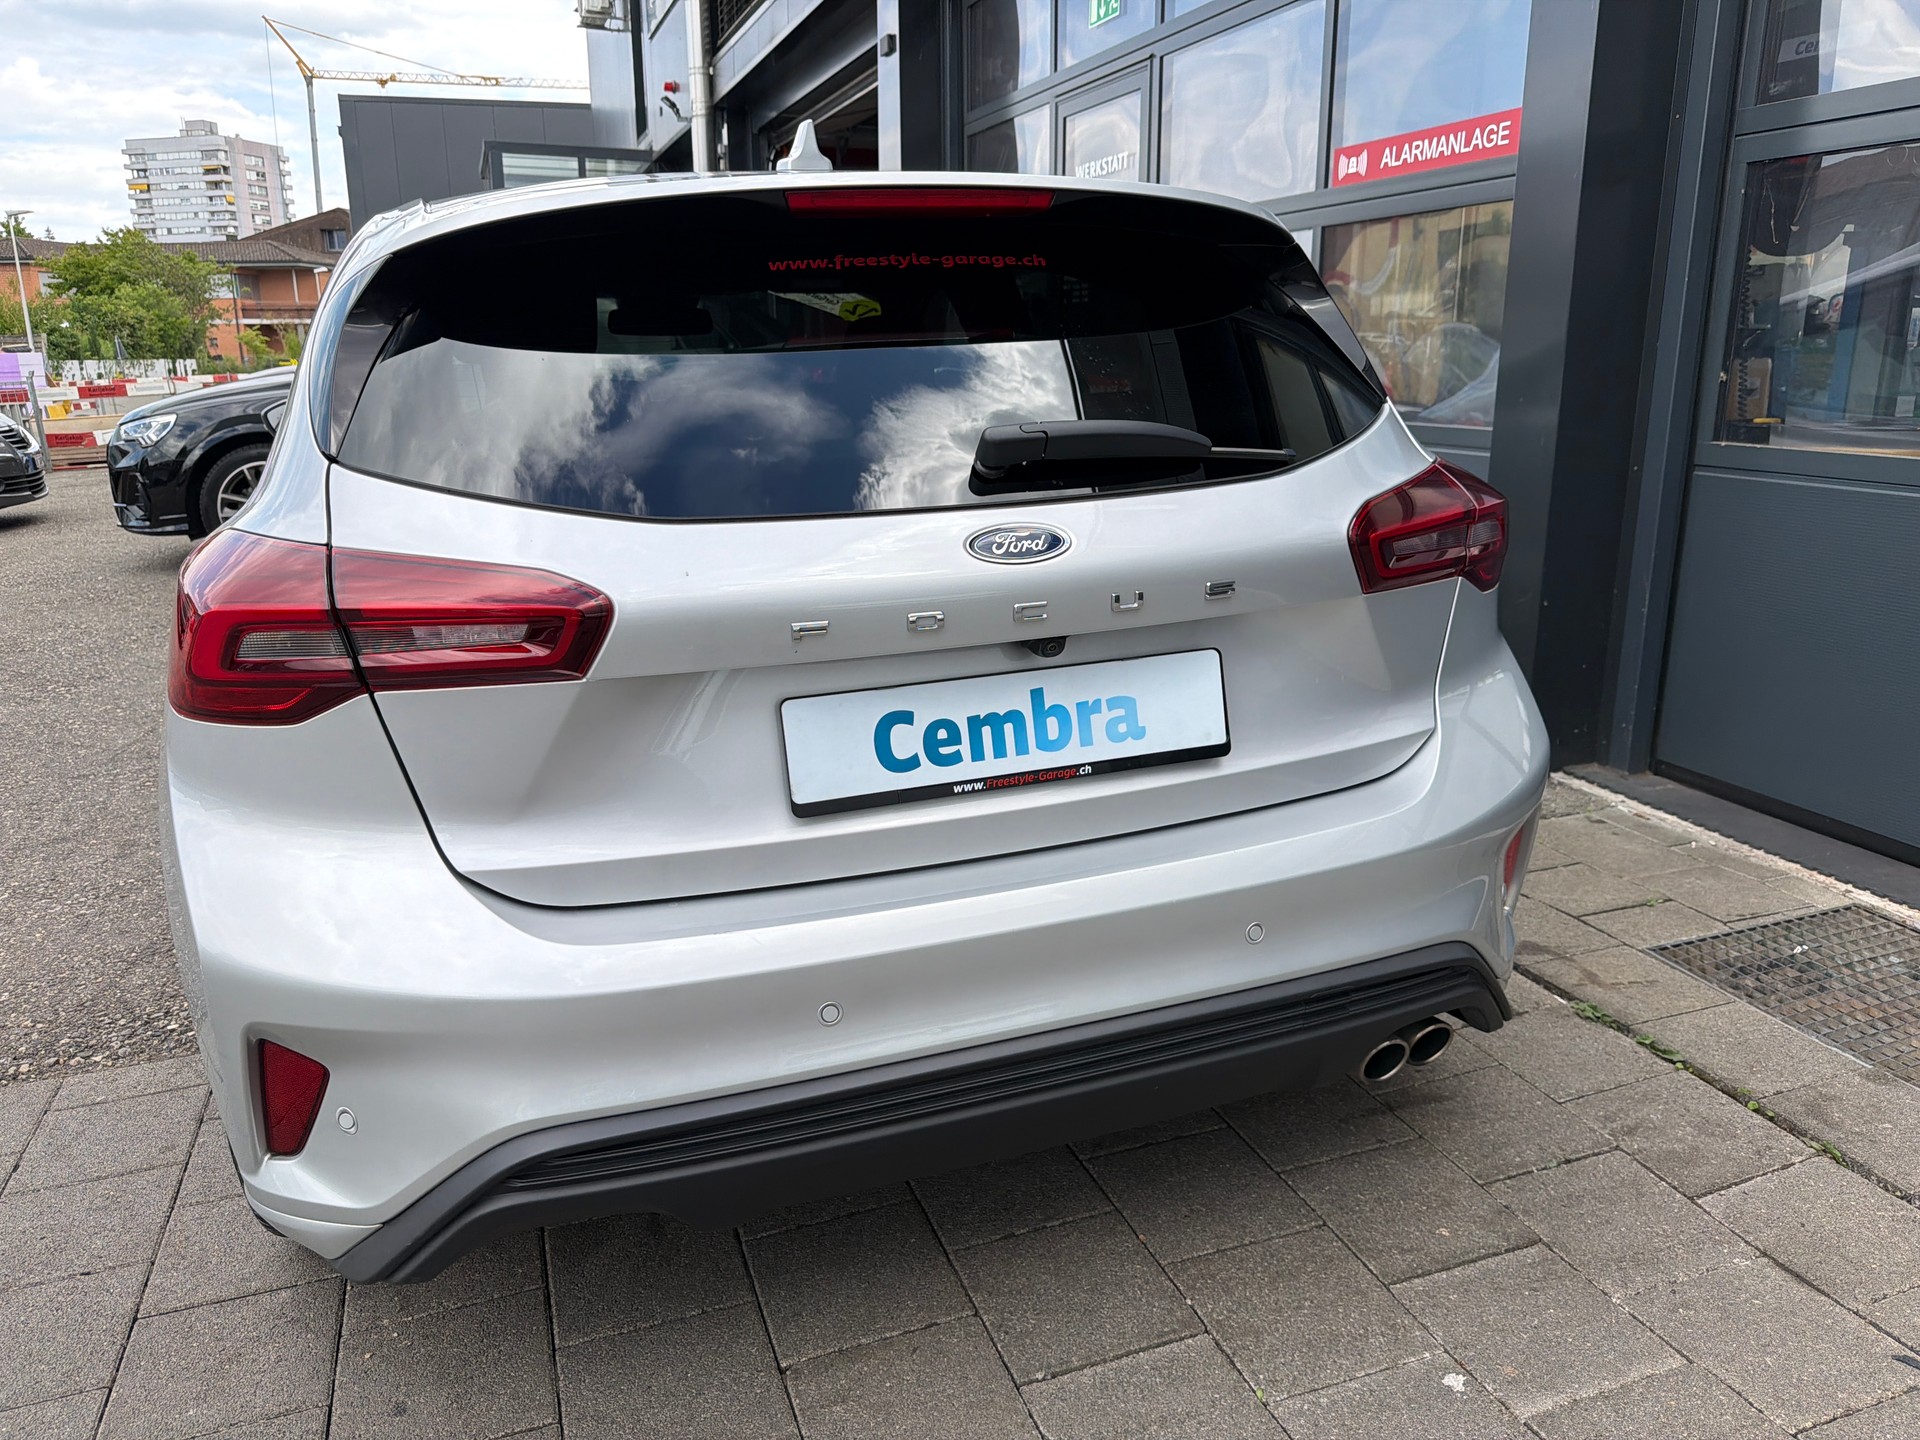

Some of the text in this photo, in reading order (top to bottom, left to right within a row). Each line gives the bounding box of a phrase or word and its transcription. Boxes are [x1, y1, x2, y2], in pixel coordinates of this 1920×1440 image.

[1380, 121, 1511, 169] ALARMANLAGE
[1075, 151, 1129, 179] WERKSTATT
[768, 253, 1046, 271] www.freestyle-garage.ch
[992, 531, 1048, 554] Ford
[790, 579, 1236, 641] FOCUS
[873, 687, 1146, 773] Cembra
[953, 764, 1092, 793] www.Freestyle-Garage.ch
